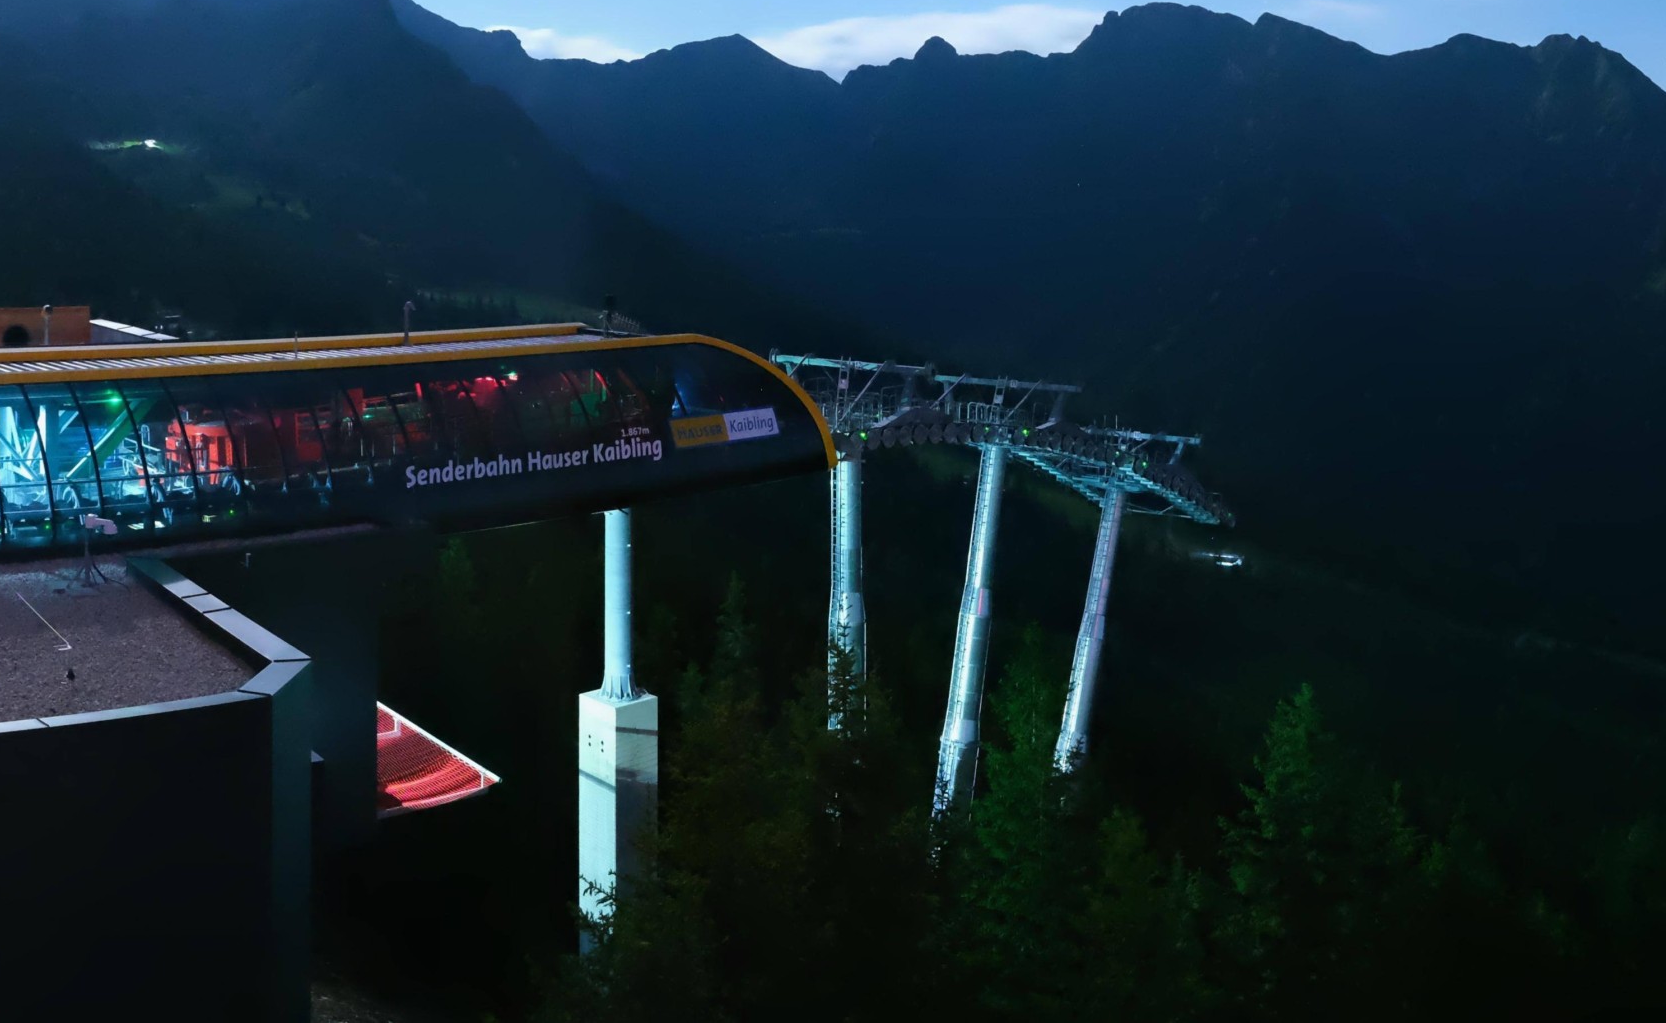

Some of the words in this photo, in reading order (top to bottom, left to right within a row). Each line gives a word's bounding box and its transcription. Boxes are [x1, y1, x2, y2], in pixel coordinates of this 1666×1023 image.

[729, 416, 774, 433] Kaibling
[405, 456, 523, 488] Senderbahn
[527, 449, 589, 472] Hauser
[592, 438, 663, 464] Kaibling
